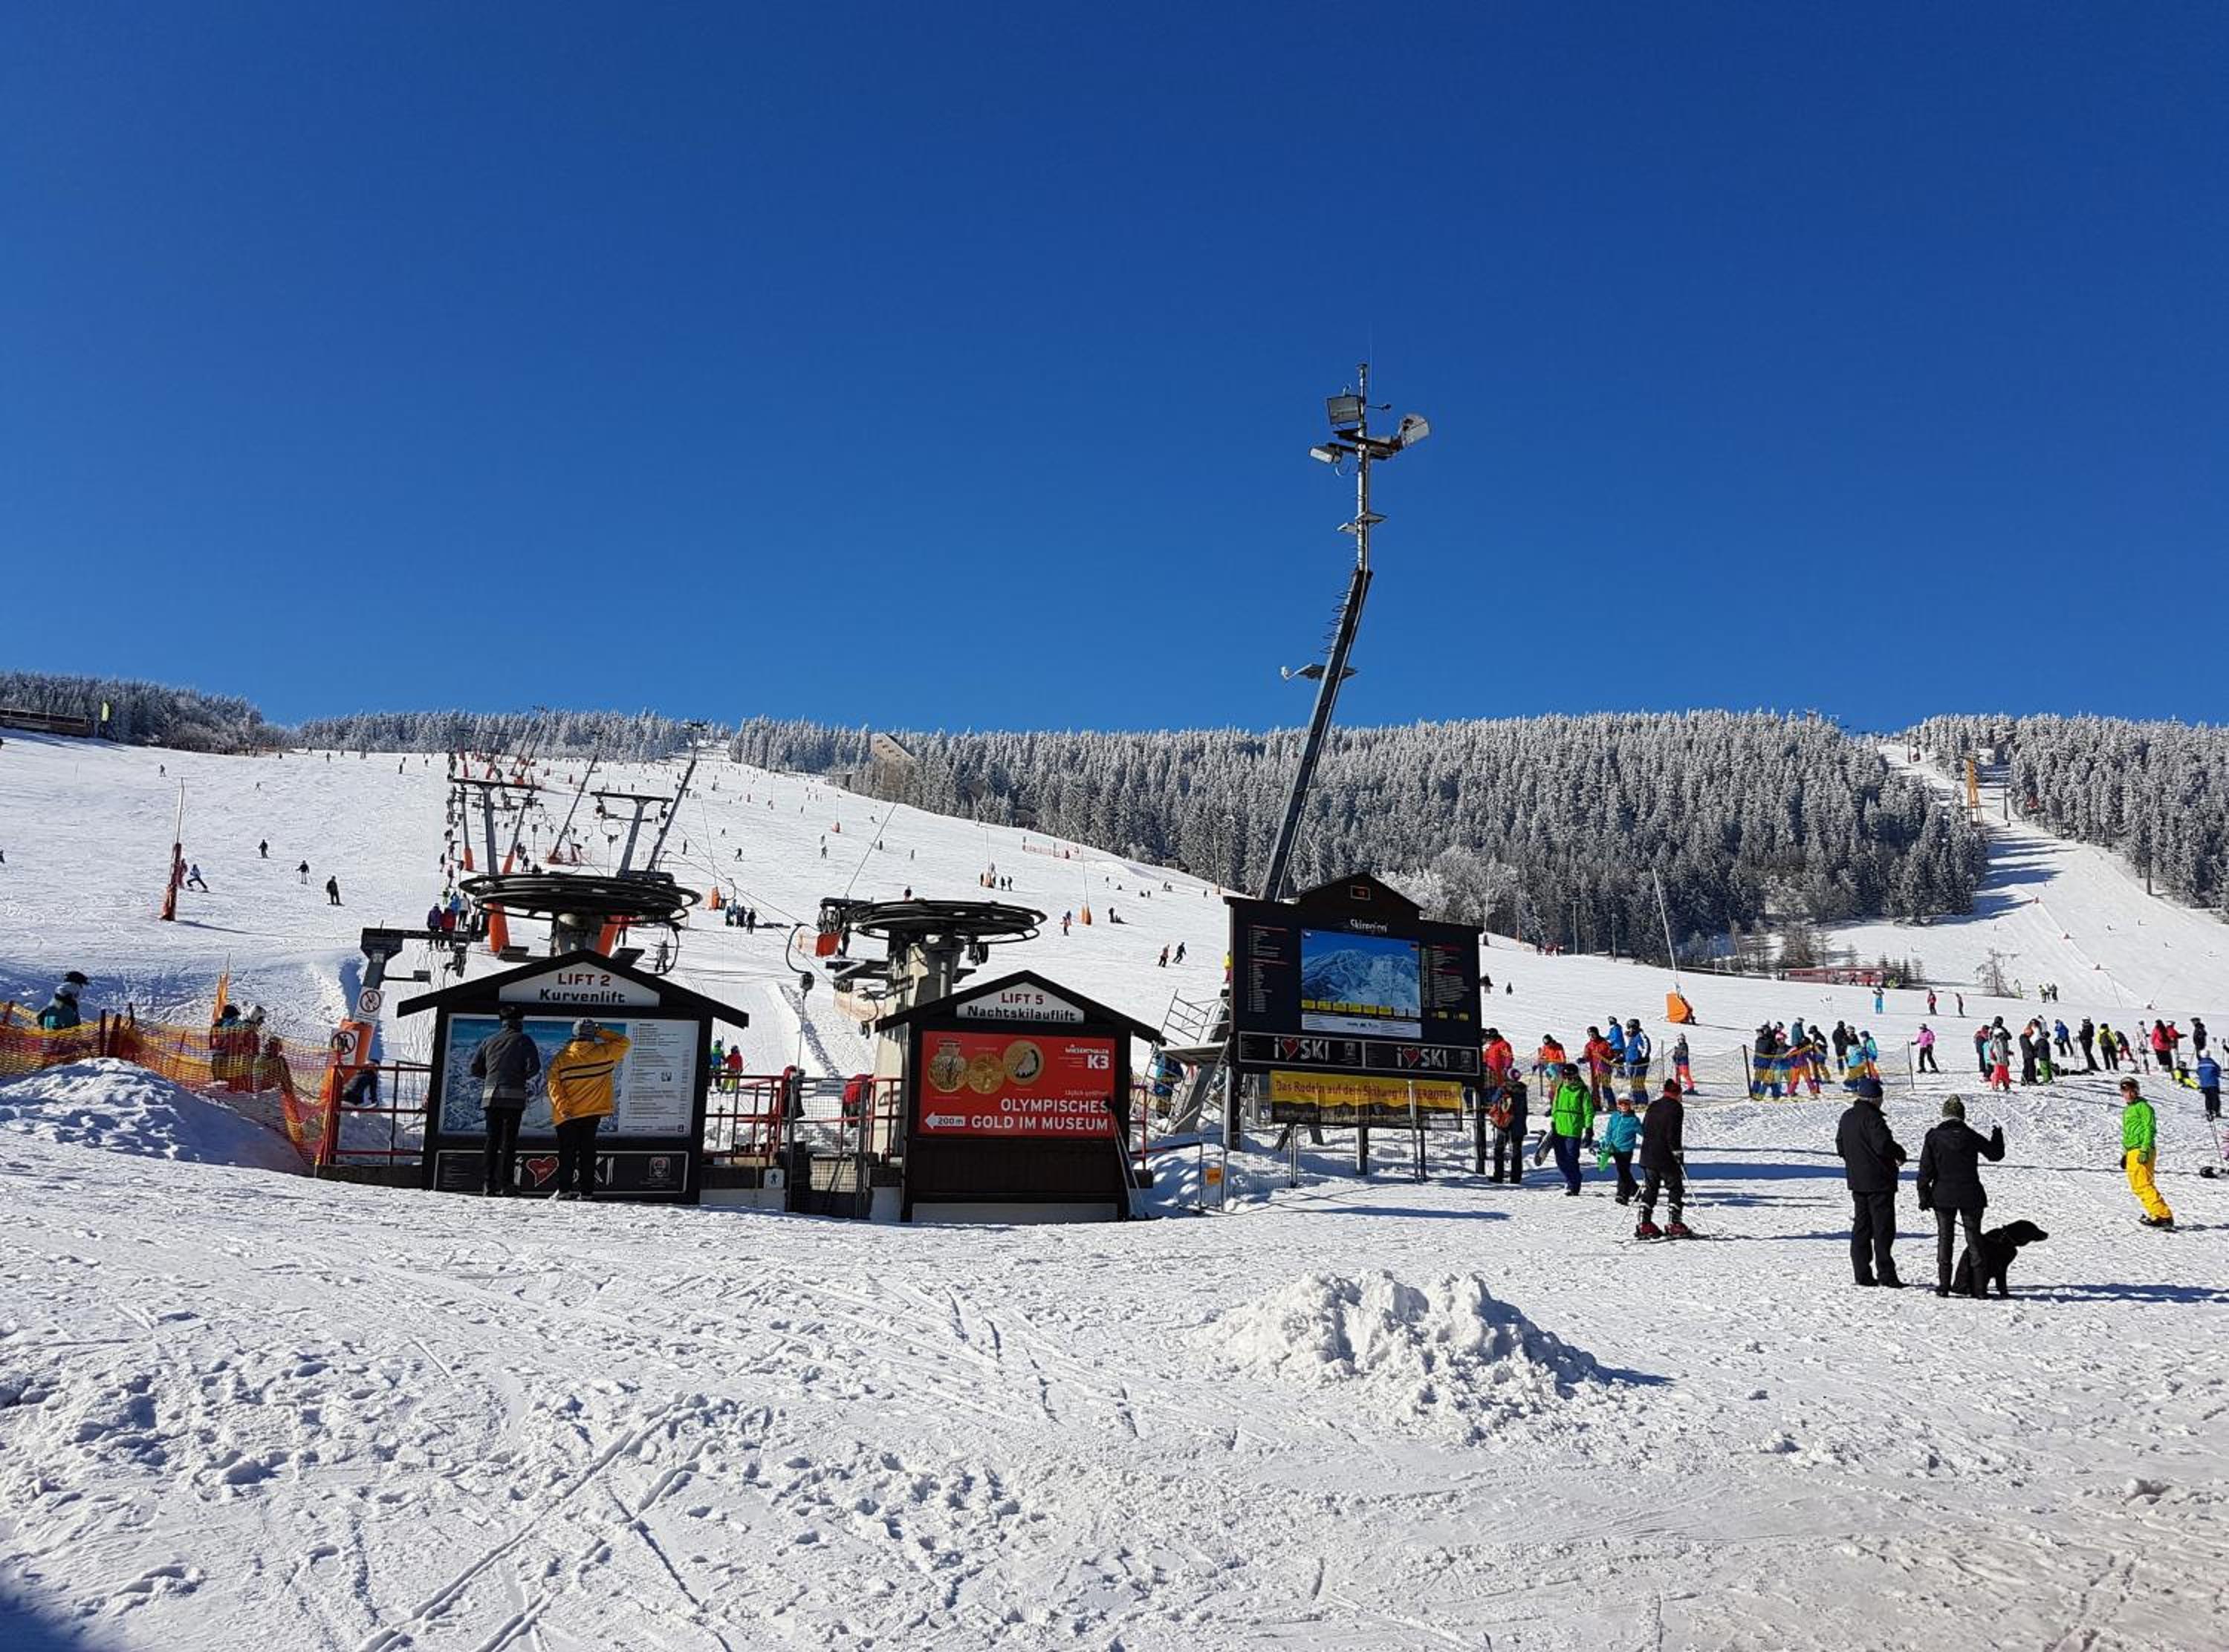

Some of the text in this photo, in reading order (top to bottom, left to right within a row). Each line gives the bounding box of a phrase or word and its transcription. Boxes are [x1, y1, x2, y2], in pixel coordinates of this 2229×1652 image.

[558, 973, 611, 986] LIFT 2
[539, 989, 626, 1003] Kurvenlift
[1001, 992, 1044, 1005] LIFT 5
[967, 1005, 1076, 1021] Nachtskilauflift
[1300, 1039, 1330, 1061] SKI
[1087, 1054, 1109, 1069] K3
[1420, 1048, 1448, 1070] SKI
[1001, 1098, 1109, 1113] OLYMPISCHES
[971, 1115, 1108, 1131] GOLD IM MUSEUM
